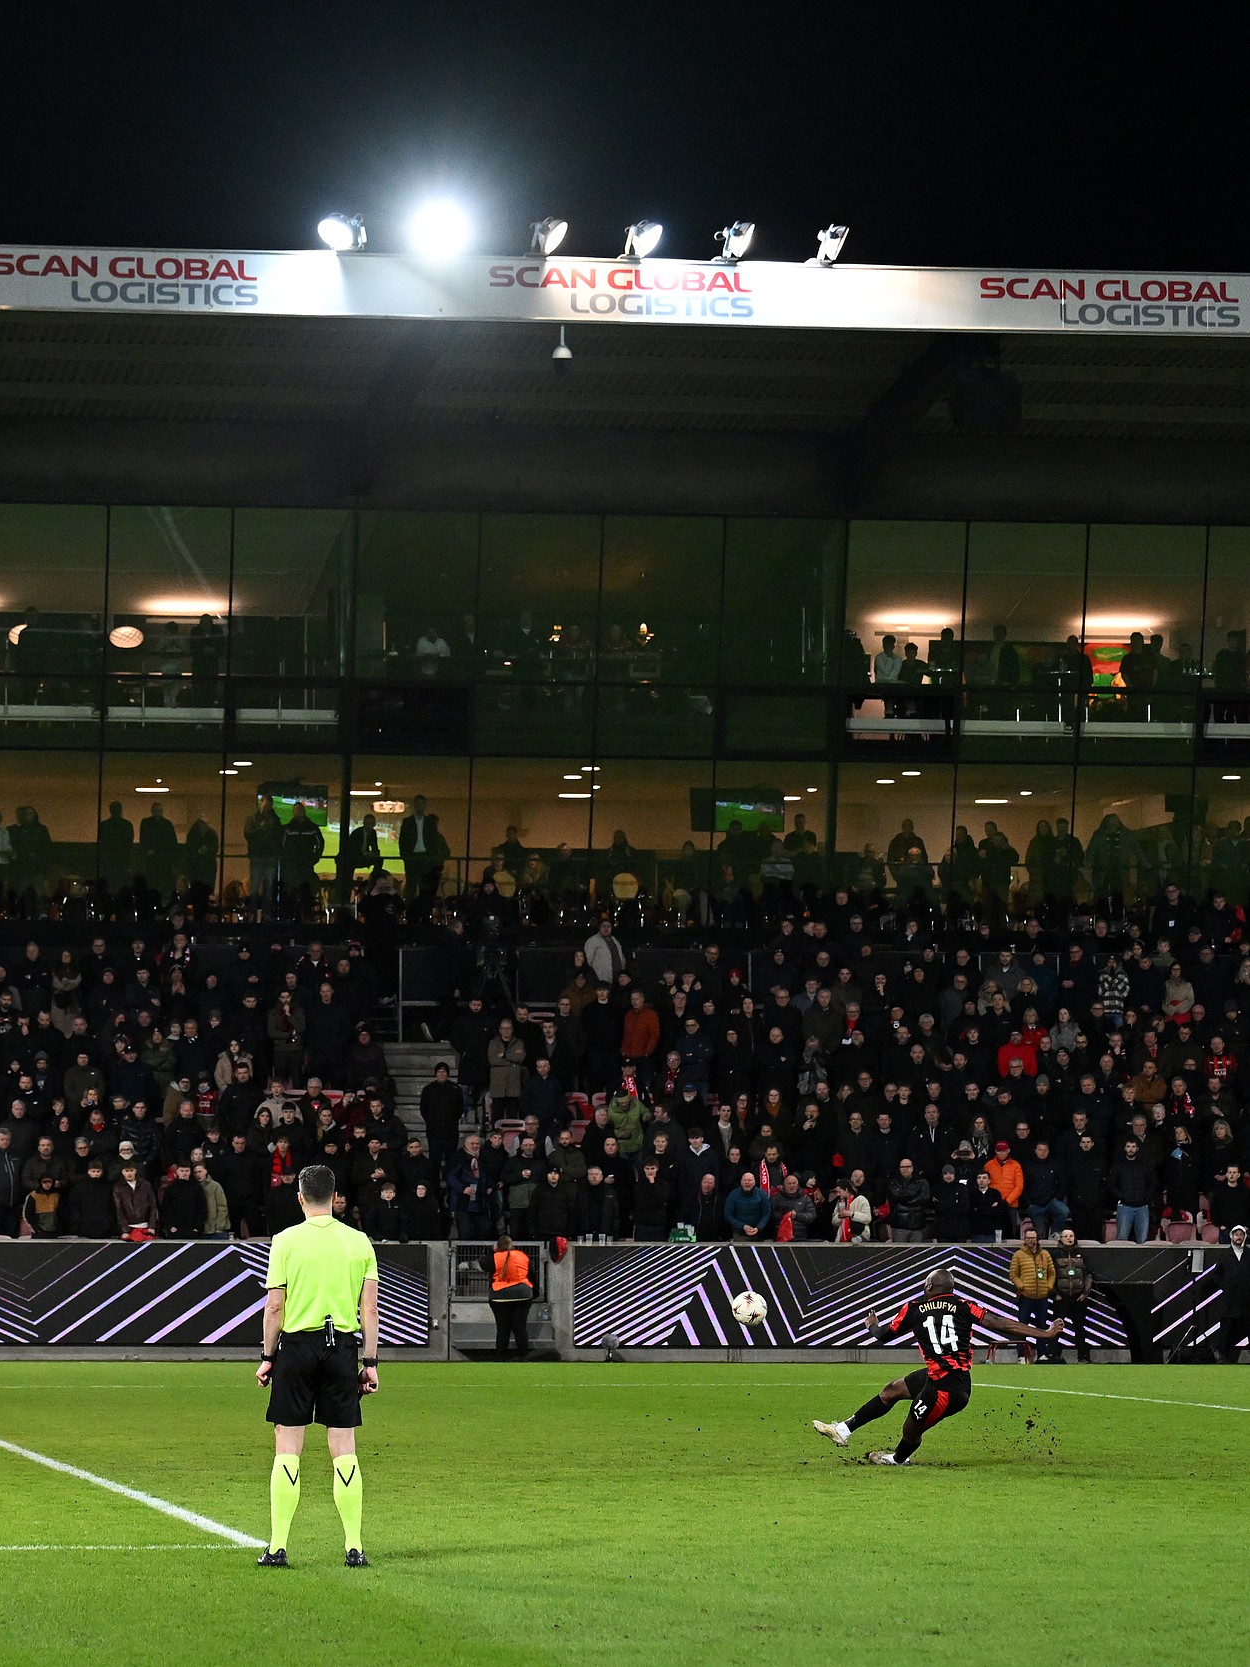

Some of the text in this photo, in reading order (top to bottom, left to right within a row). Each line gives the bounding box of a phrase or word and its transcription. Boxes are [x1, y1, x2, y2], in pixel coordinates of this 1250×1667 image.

[108, 256, 258, 282] GLOBAL
[488, 265, 753, 293] SCAN GLOBAL
[71, 281, 259, 306] LOGISTICS
[980, 277, 1240, 303] SCAN GLOBAL
[570, 293, 754, 318] LOGISTICS
[1059, 303, 1241, 328] LOGISTICS
[918, 1301, 957, 1313] CHILUFYA
[922, 1314, 959, 1355] 14
[914, 1399, 928, 1415] 14
